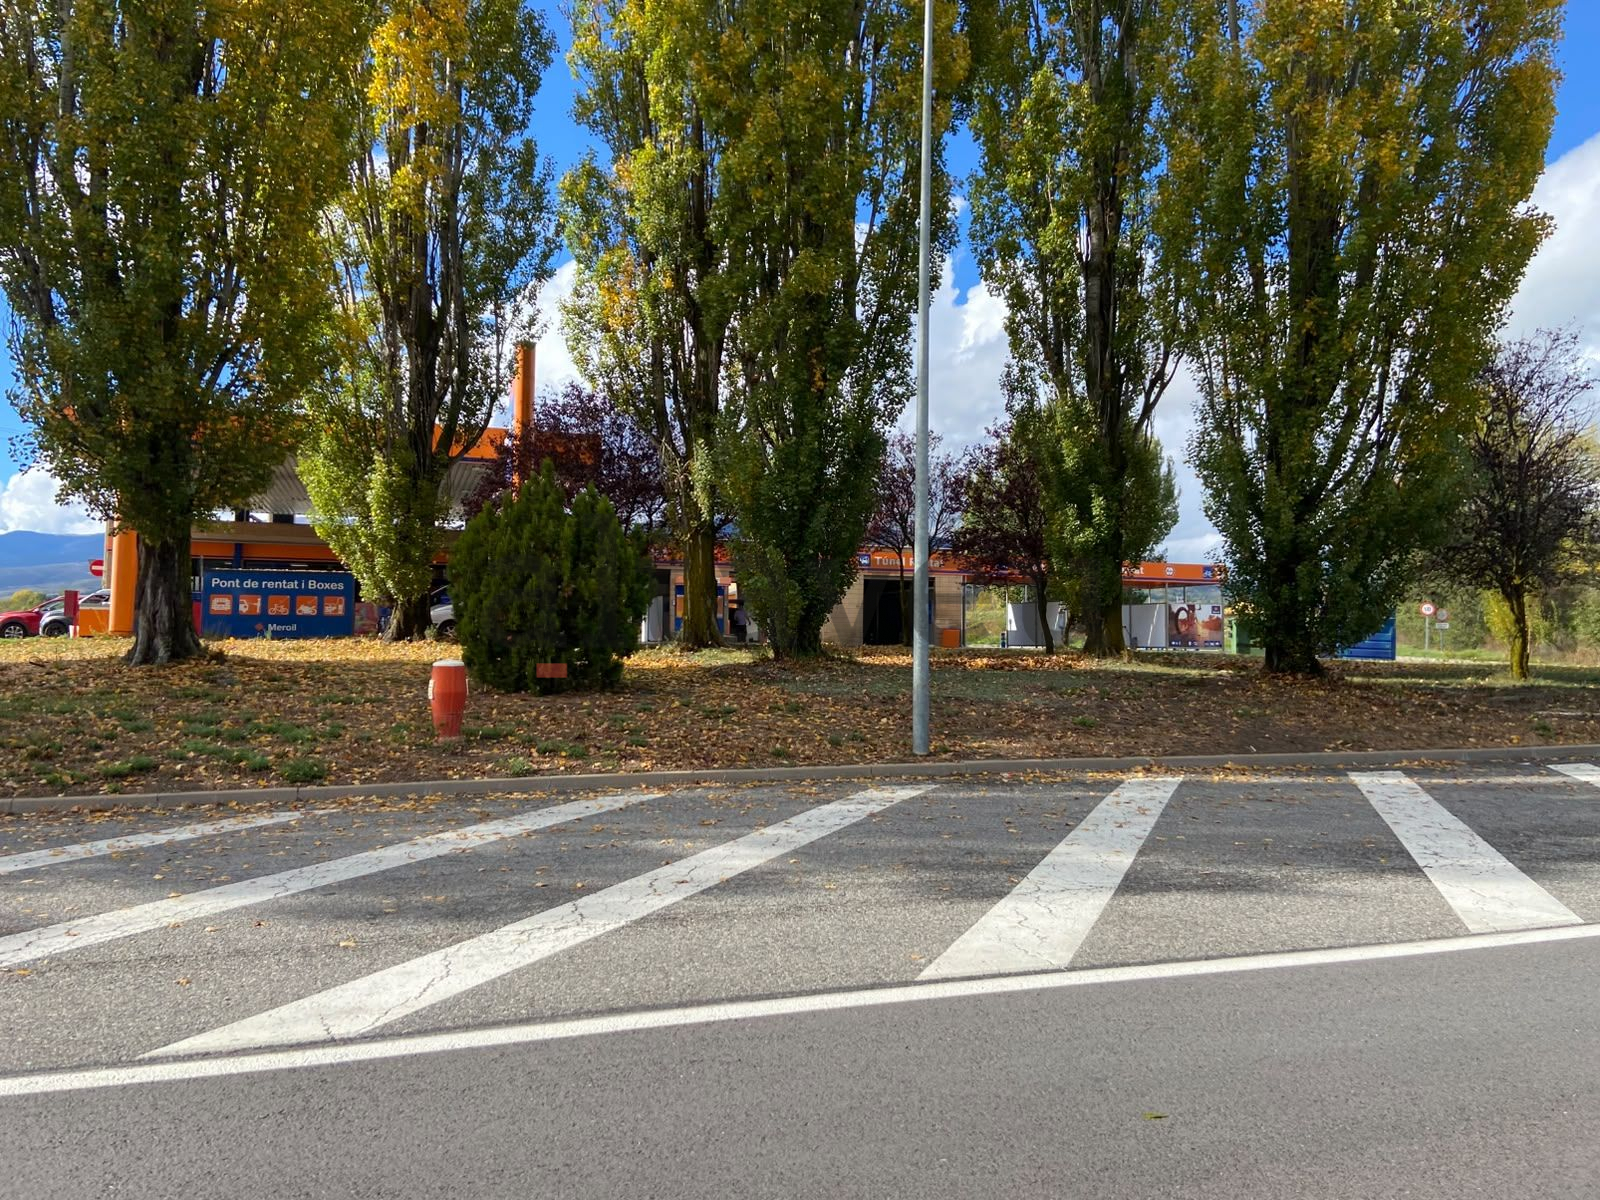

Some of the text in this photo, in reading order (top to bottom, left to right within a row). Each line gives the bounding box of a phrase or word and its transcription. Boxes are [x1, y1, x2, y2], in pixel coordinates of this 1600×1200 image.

[211, 577, 240, 588] Pont
[243, 578, 259, 588] de
[261, 579, 299, 589] rentat
[301, 580, 305, 589] i
[308, 579, 344, 590] Boxes
[267, 623, 297, 631] Meroil
